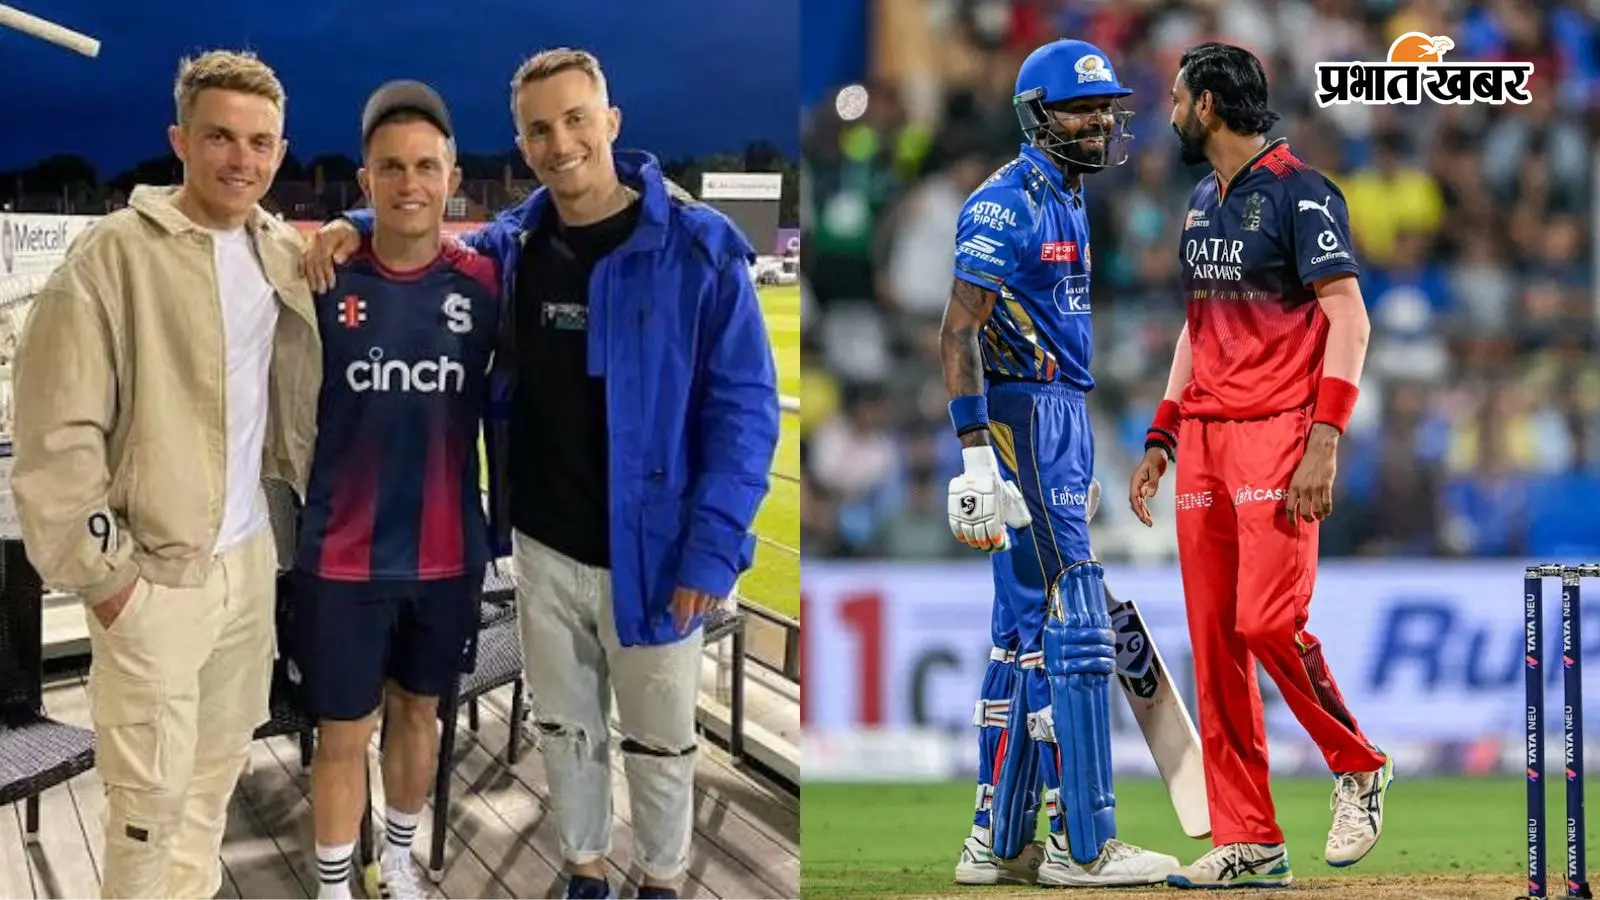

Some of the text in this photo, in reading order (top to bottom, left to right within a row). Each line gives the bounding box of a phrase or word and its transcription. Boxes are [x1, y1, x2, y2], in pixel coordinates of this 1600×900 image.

[14, 220, 68, 252] Metcalf
[969, 201, 1017, 227] ASTRAL
[973, 214, 1004, 231] PIPES
[1186, 238, 1244, 267] QATAR
[1193, 264, 1242, 281] AIRWAYS
[346, 347, 465, 392] cinch
[87, 511, 111, 554] 9
[1526, 593, 1536, 653] TATA NEU
[1562, 591, 1571, 652] TATA NEU
[1528, 706, 1537, 765] TATA NEU
[1565, 705, 1574, 765] TATA NEU
[1528, 818, 1538, 878] TATA NEU
[1567, 817, 1577, 878] TATA NEU
